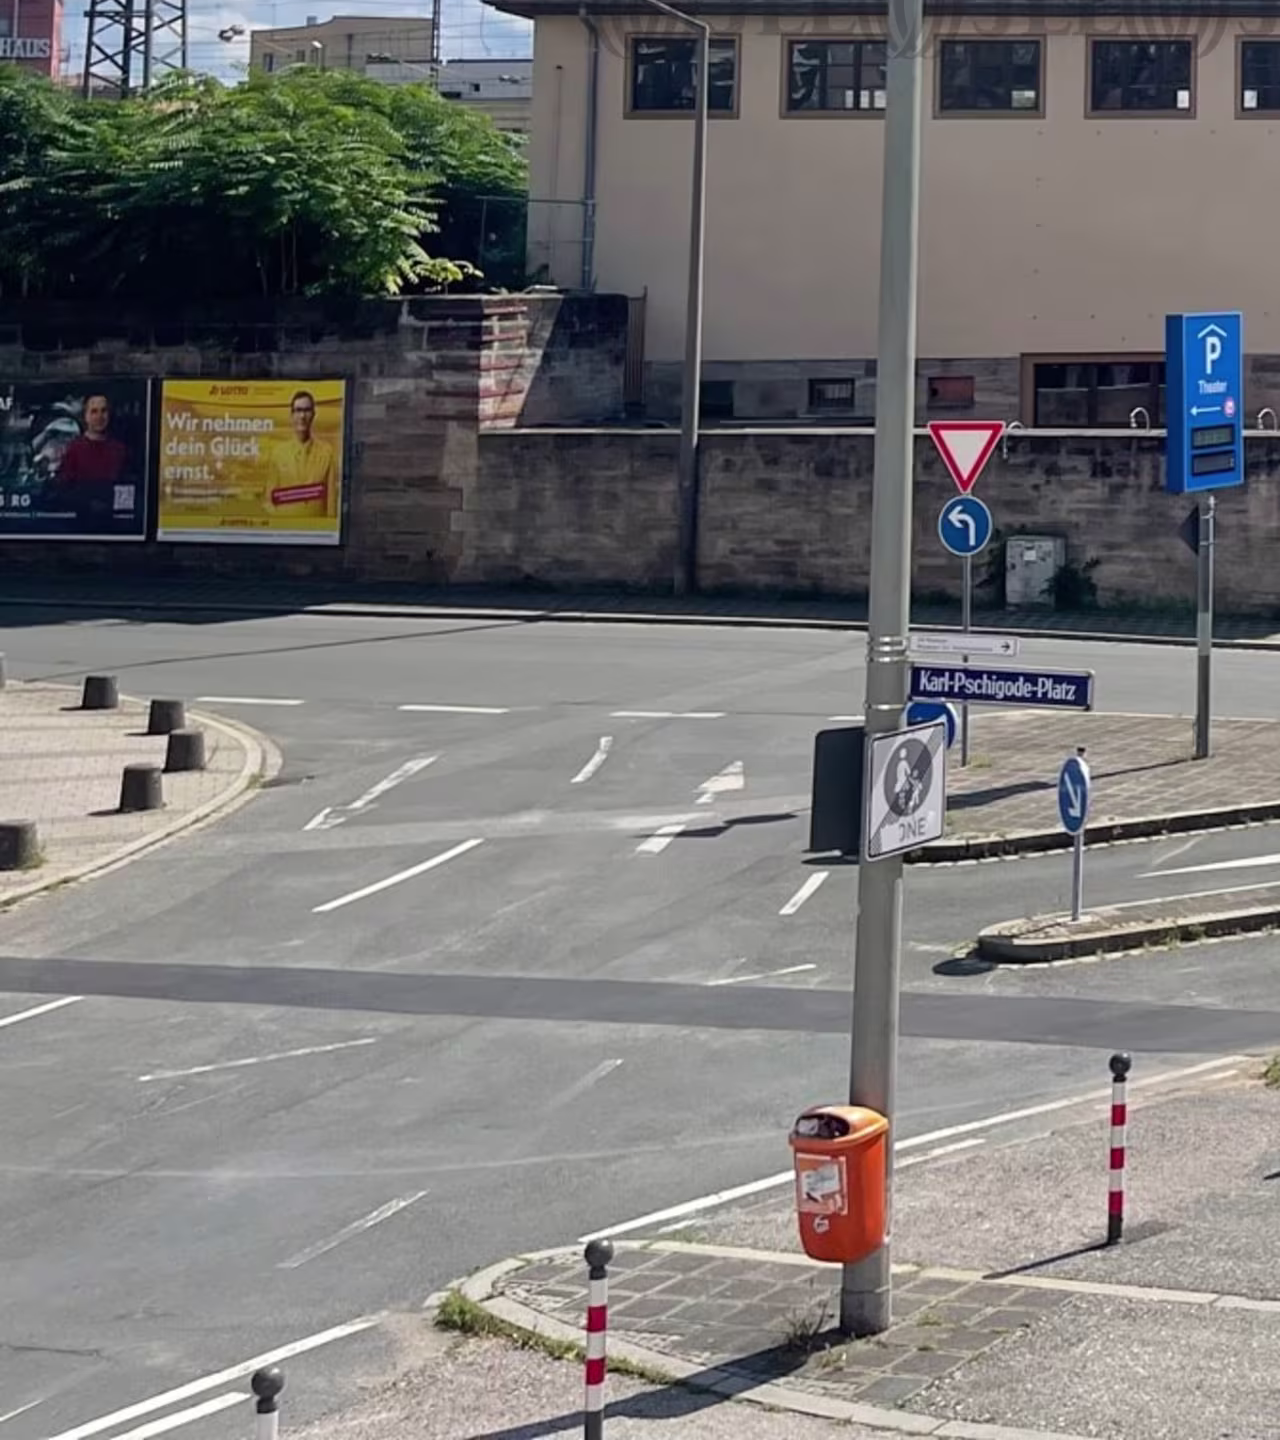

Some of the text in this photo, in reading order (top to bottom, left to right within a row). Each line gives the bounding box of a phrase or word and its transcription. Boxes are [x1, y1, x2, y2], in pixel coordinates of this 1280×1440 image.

[1205, 335, 1221, 374] P
[167, 412, 274, 432] Wir nehmen
[166, 437, 260, 457] dein Glück
[919, 669, 1078, 701] Karl-Pschigode-Platz
